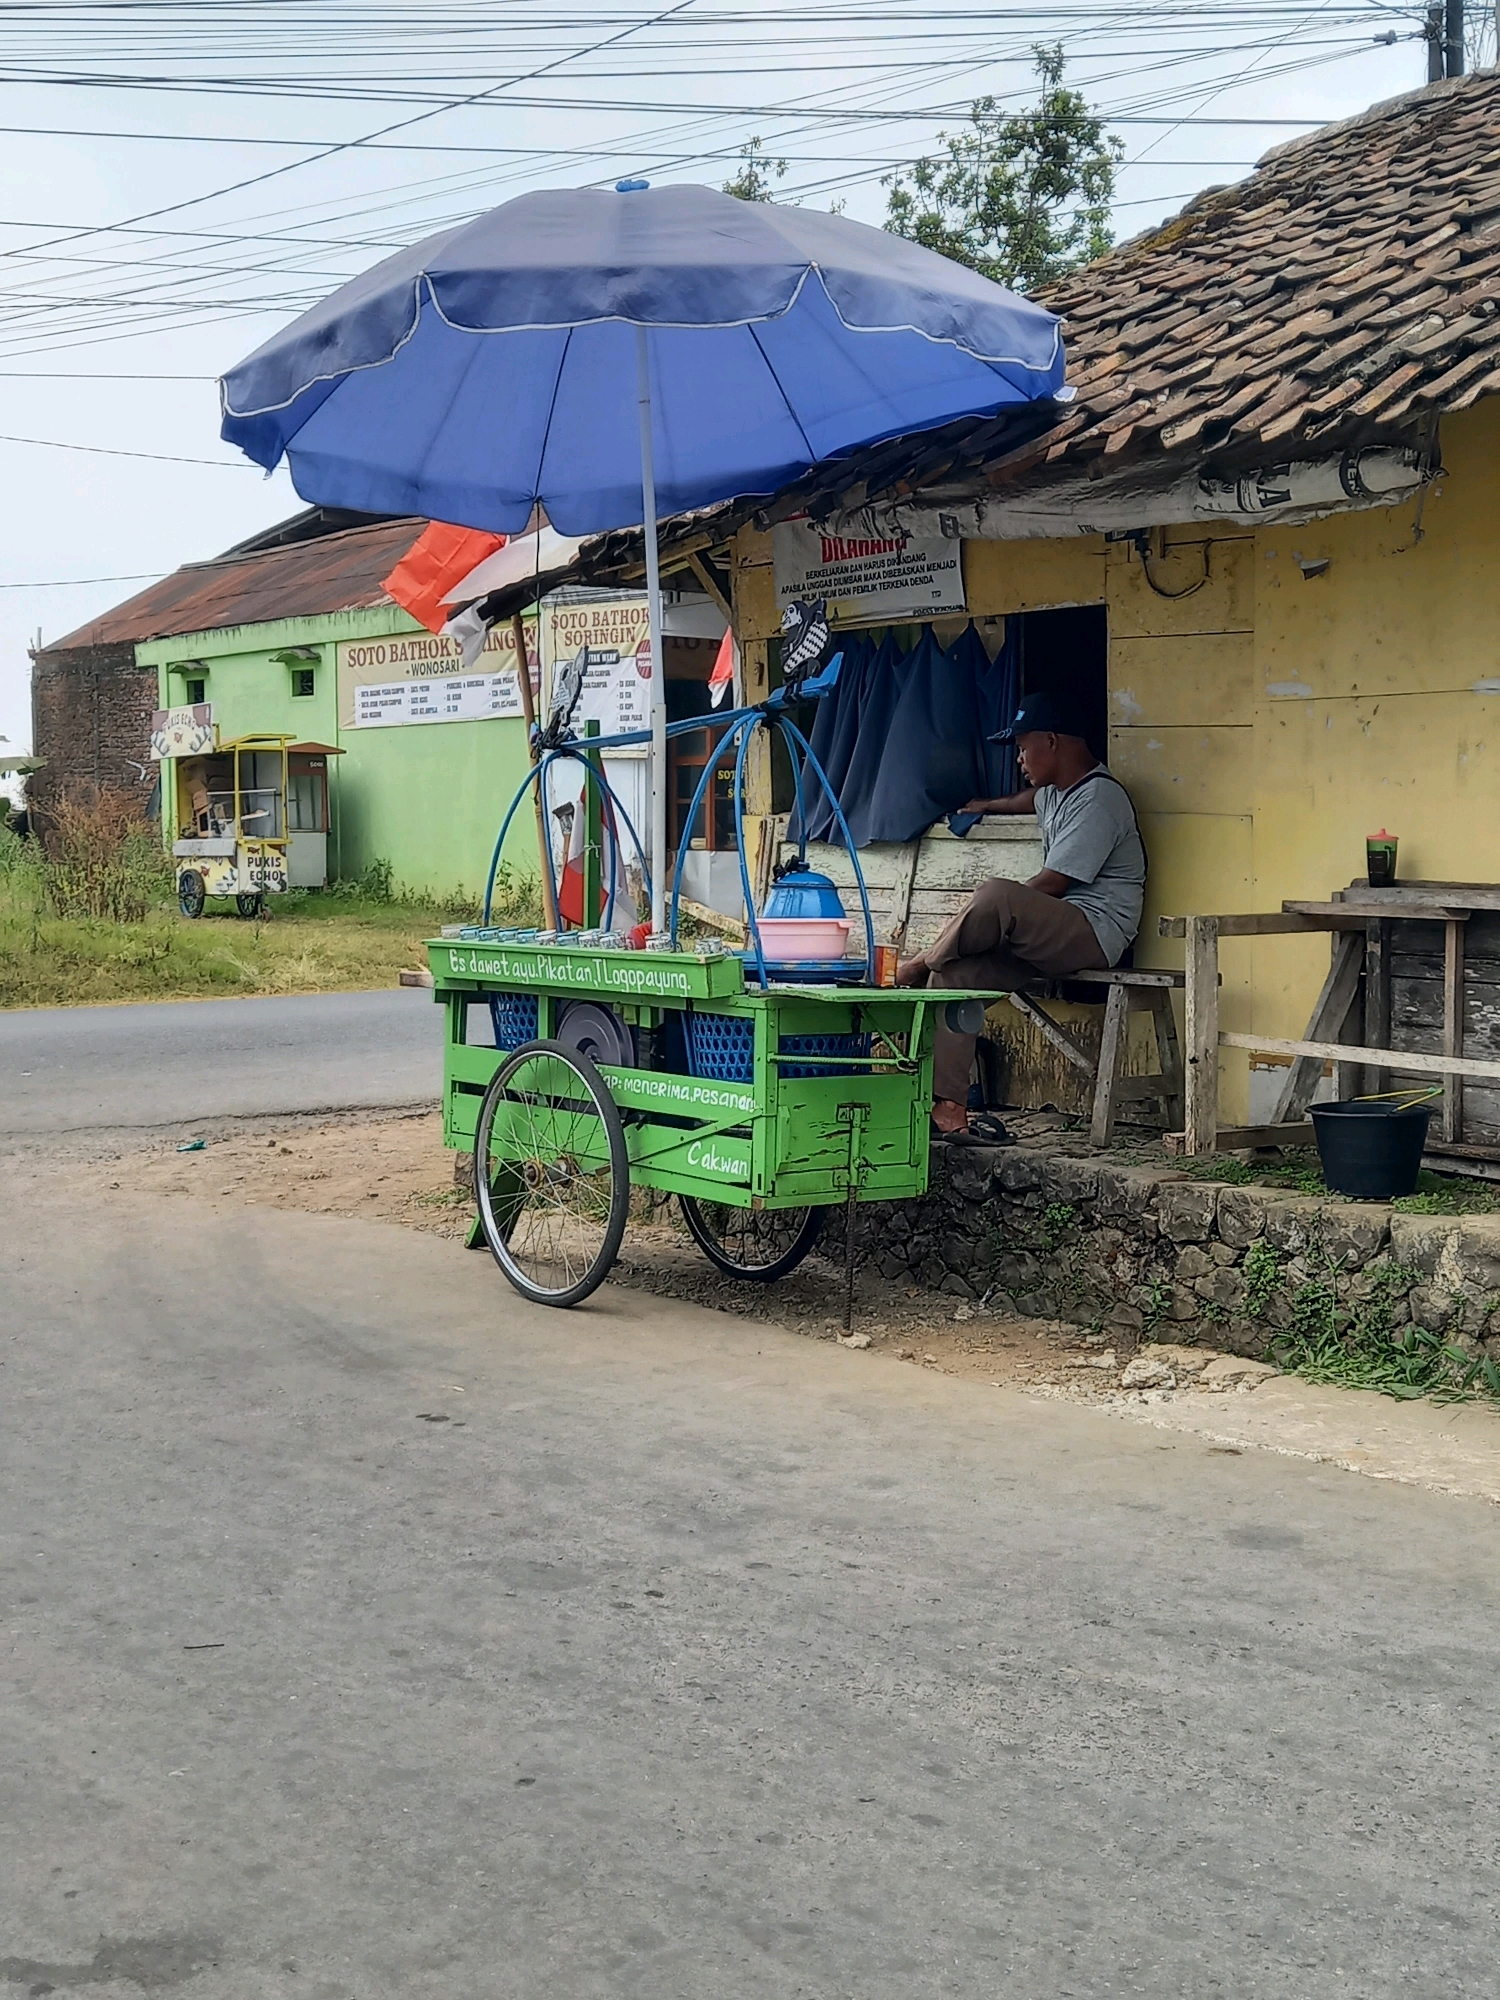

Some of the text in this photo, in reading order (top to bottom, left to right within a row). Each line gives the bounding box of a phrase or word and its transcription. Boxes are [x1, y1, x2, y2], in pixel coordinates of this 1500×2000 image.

[806, 579, 833, 591] UNGGAS
[833, 574, 863, 587] DIUMBAR
[863, 570, 882, 583] MAKA
[882, 563, 926, 580] DIBEBASKAN
[926, 559, 957, 573] MENJADI
[850, 563, 863, 573] DAN
[863, 557, 886, 570] HARUS
[838, 586, 852, 597] DAN
[878, 579, 910, 591] TERKENA
[910, 574, 935, 587] DENDA
[551, 607, 650, 630] SOTO BATHOK
[347, 626, 538, 668] SOTO BATHOK SINGN
[564, 626, 636, 647] SORINGIN
[411, 658, 460, 677] WONOSARI
[247, 856, 281, 868] PUKIS
[249, 870, 280, 881] ECHO
[449, 948, 466, 972] Es
[469, 950, 510, 976] dawet
